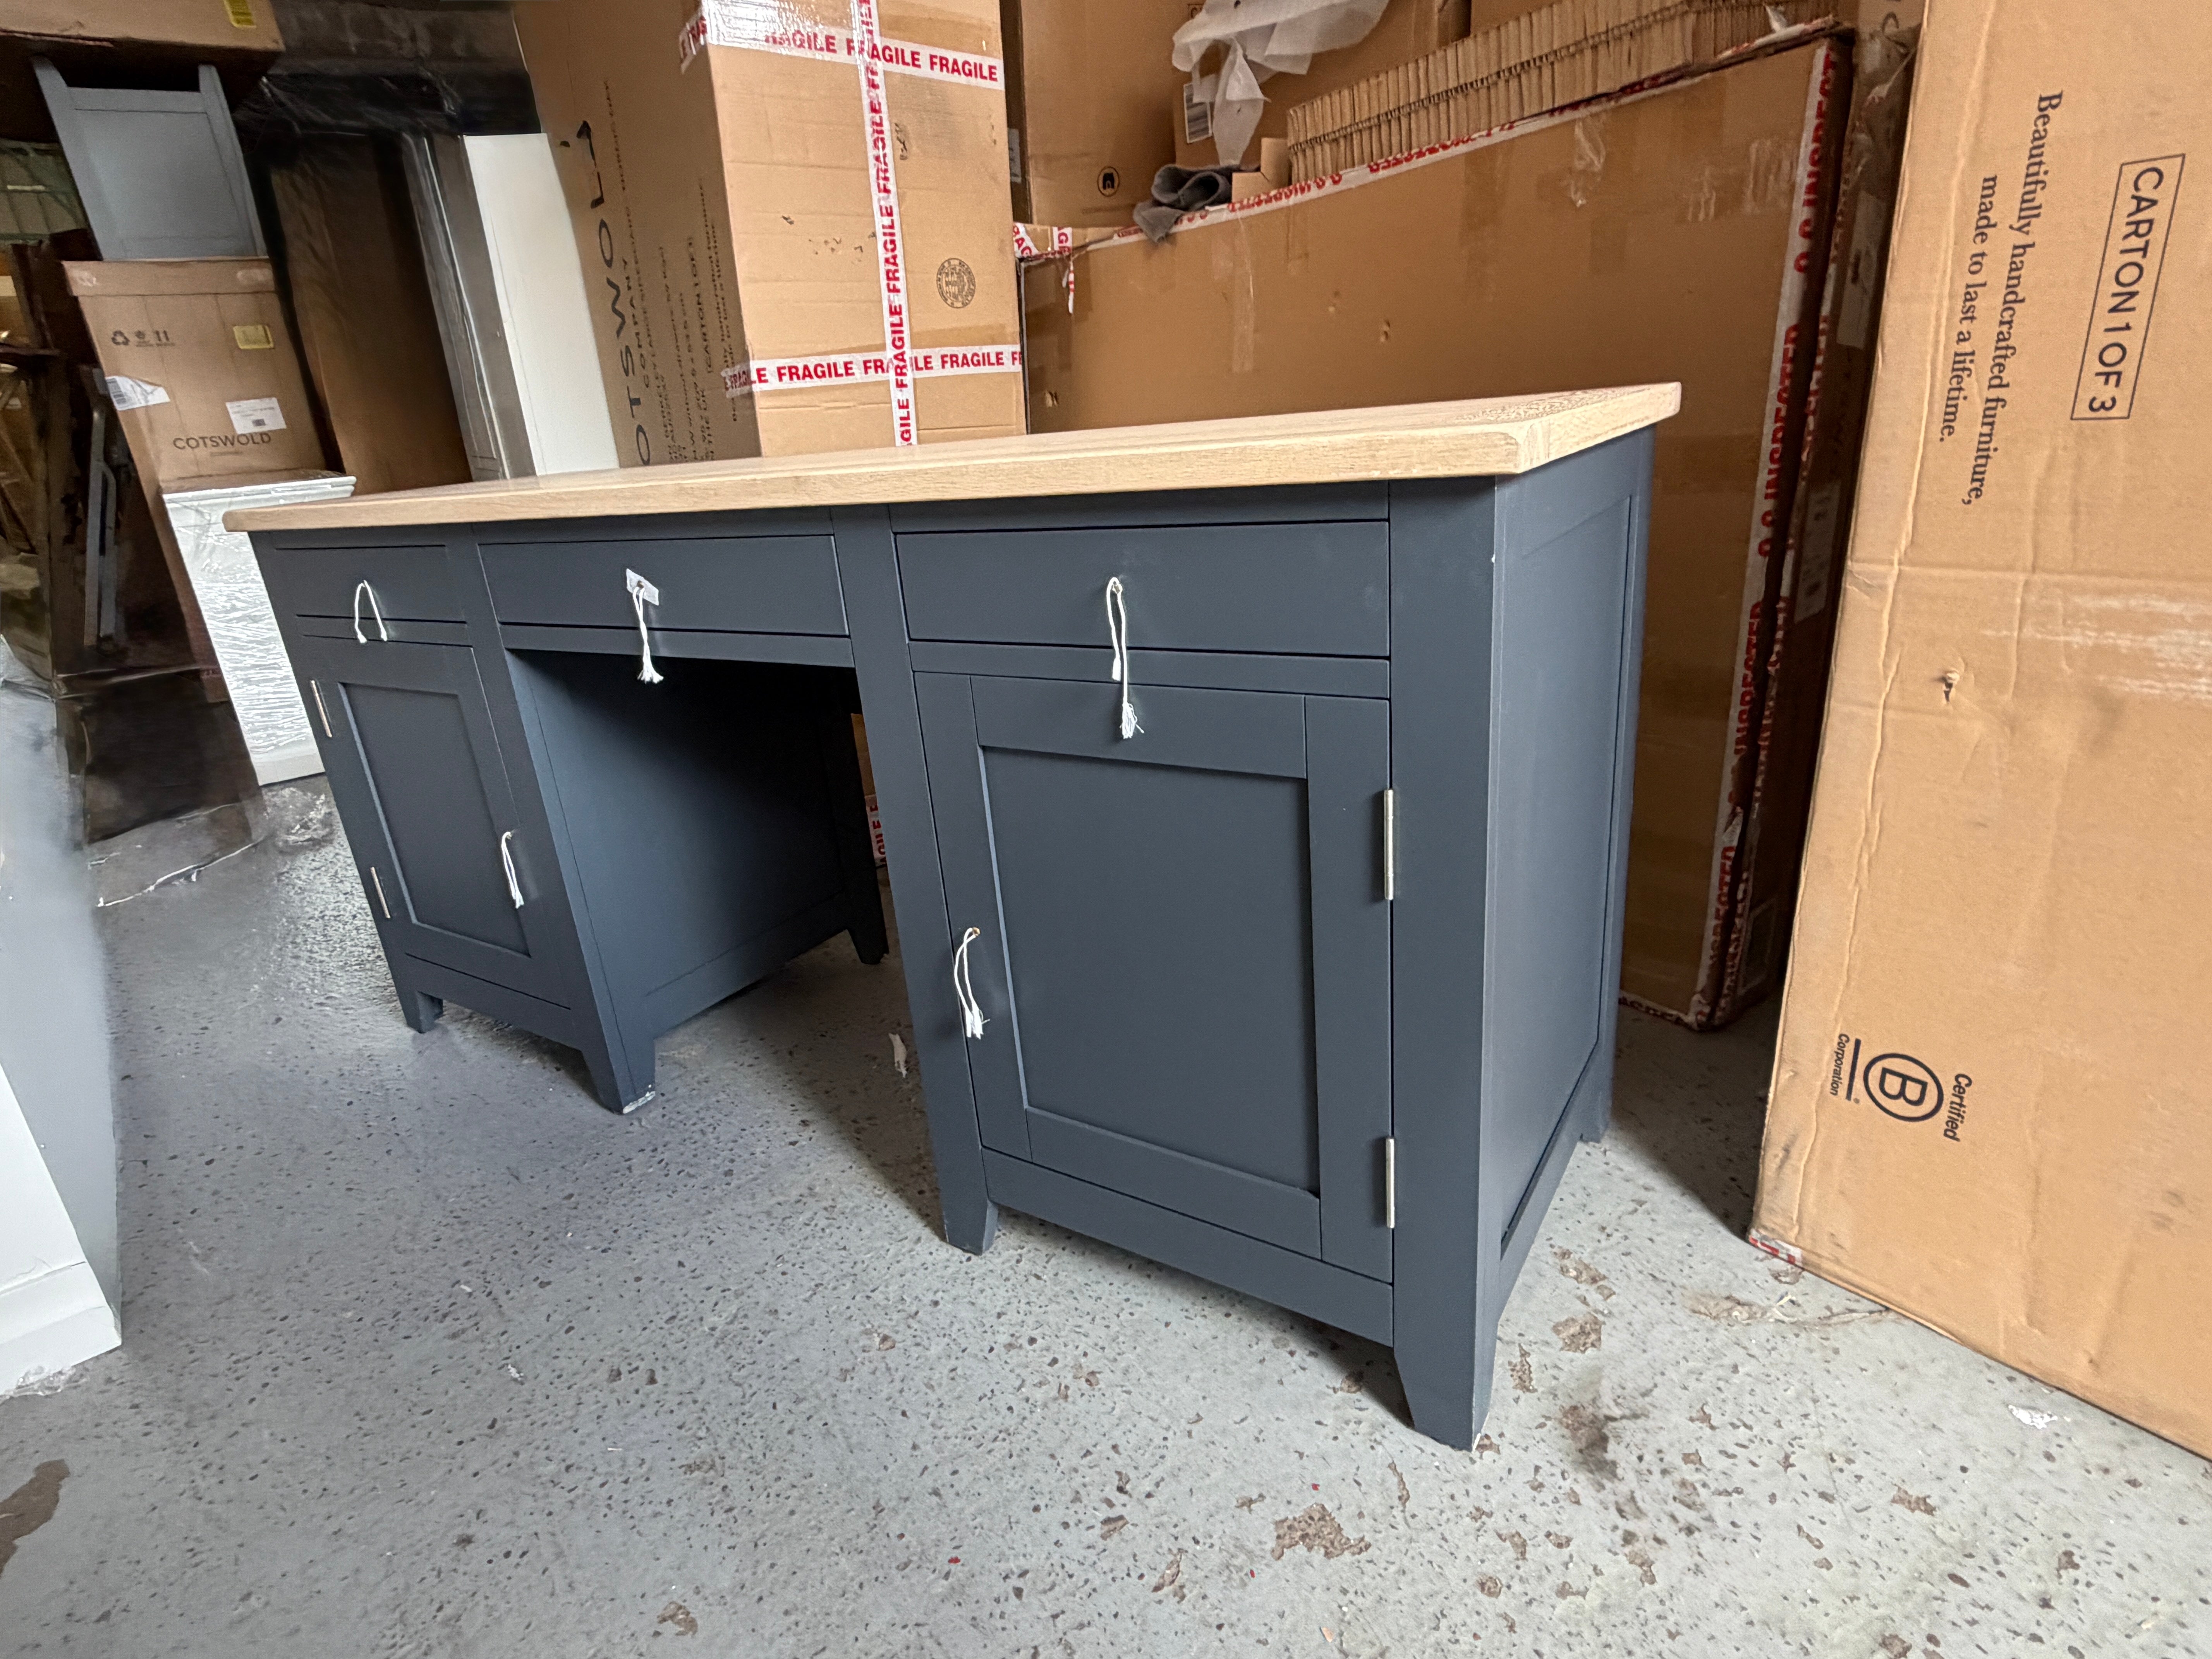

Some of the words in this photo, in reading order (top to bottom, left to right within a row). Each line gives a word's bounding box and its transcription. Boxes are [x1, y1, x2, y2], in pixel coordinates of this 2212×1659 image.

[929, 54, 998, 82] FRAGILE
[870, 100, 891, 194] FRAGILE
[2009, 89, 2063, 235] Beautifully
[1973, 174, 1998, 245] made
[2107, 167, 2164, 314] CARTON
[879, 205, 901, 294] FRAGILE
[1968, 251, 1988, 275] to
[622, 256, 650, 388] COMPANY
[1960, 281, 1987, 325] last
[1988, 242, 2035, 391] handcrafted
[2103, 321, 2133, 332] 1
[776, 361, 855, 382] FRAGILE
[940, 351, 1005, 369] FRAGILE
[889, 304, 908, 388] FRAGILE
[1956, 330, 1972, 345] a
[2094, 342, 2127, 388] OF
[1939, 349, 1976, 442] lifetime.
[2088, 396, 2116, 412] 3
[173, 433, 271, 451] COTSWOLD
[1961, 397, 2007, 505] furniture,
[1829, 1033, 1850, 1096] Corporation
[1879, 1066, 1928, 1107] B
[1943, 1073, 1973, 1142] Certified
